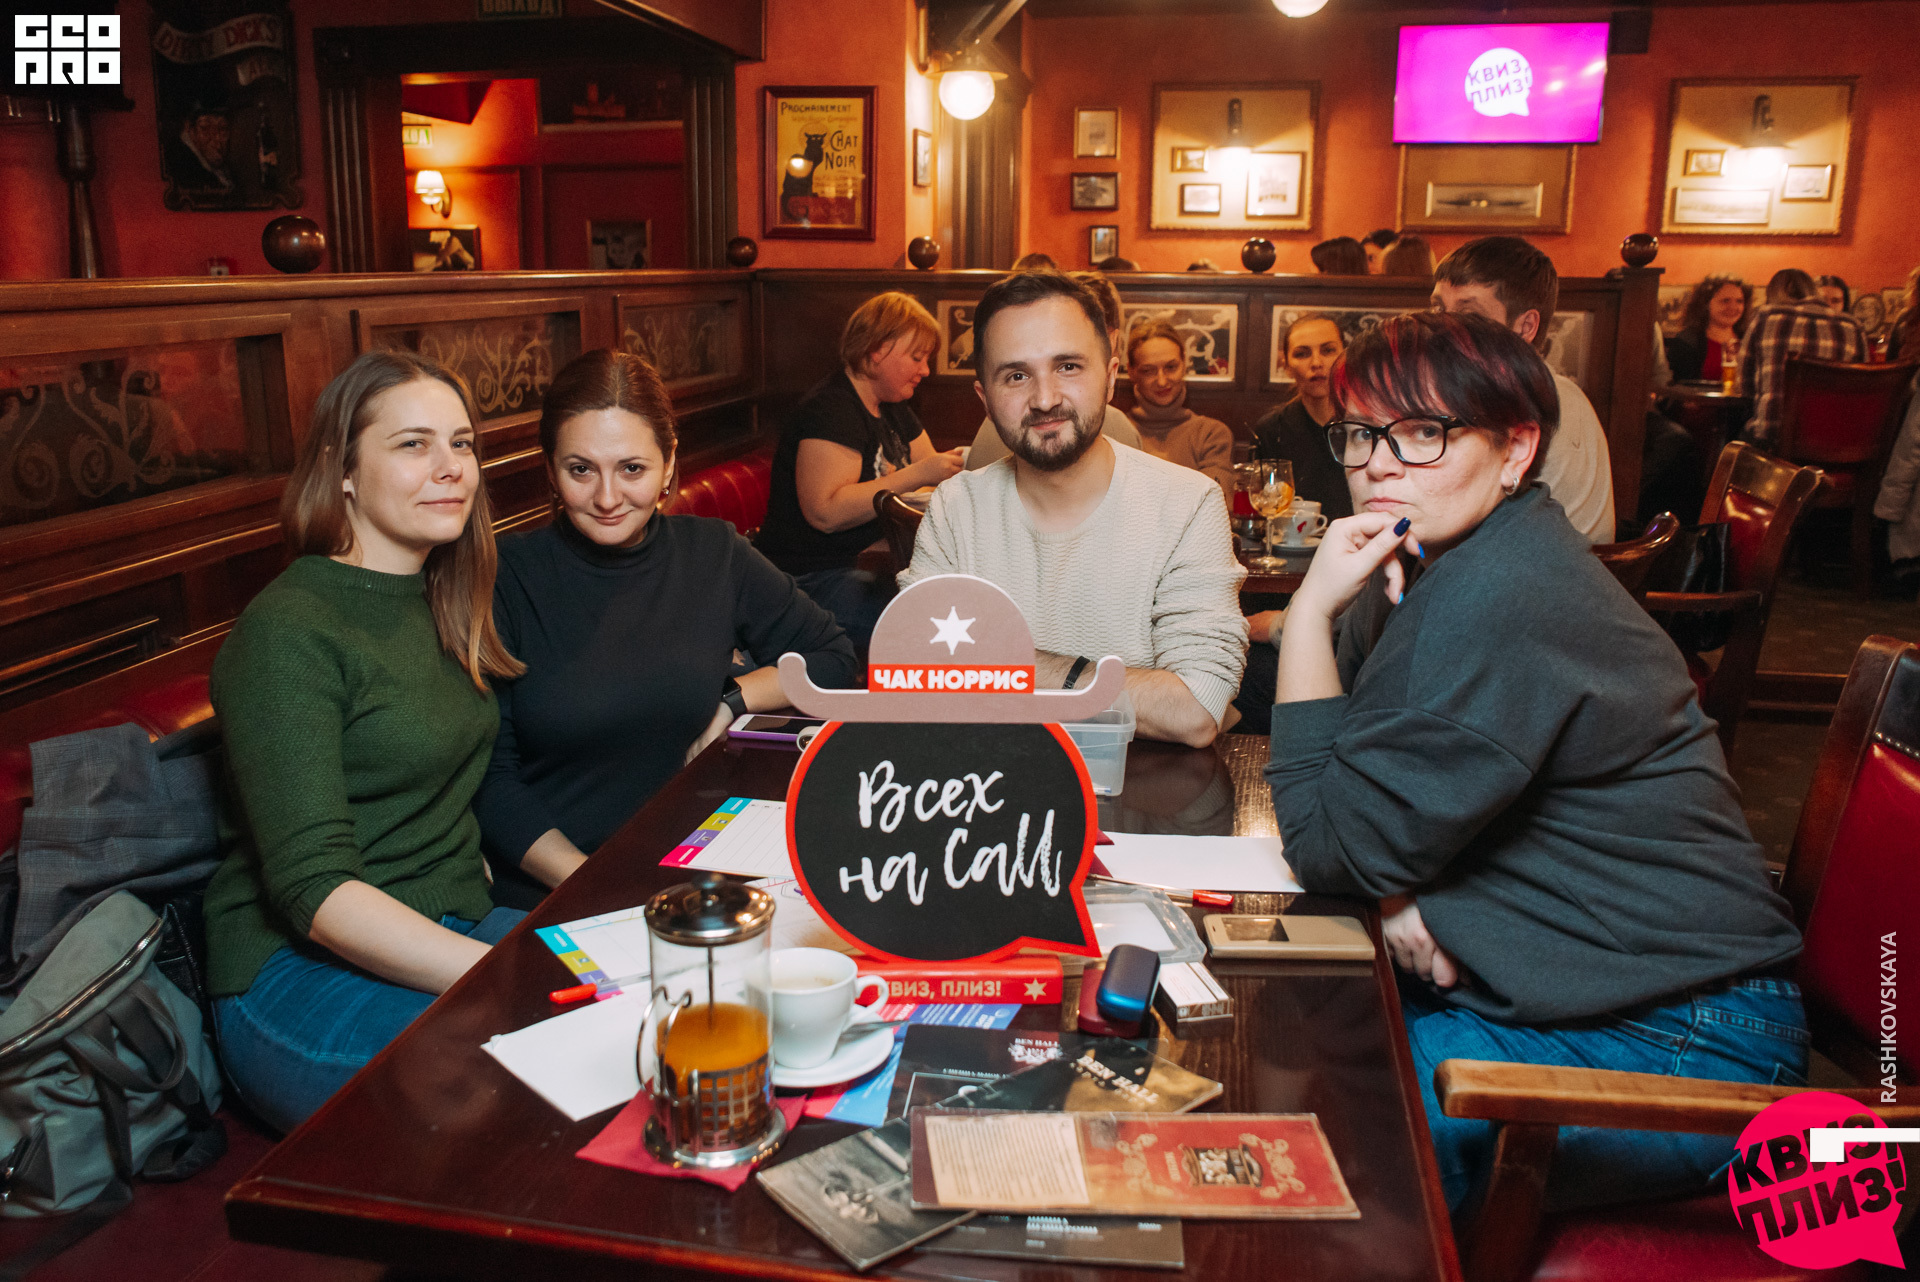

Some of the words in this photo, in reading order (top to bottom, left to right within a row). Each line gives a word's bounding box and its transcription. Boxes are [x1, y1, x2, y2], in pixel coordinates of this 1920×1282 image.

[781, 102, 851, 115] PROCHAINEMENT
[830, 130, 858, 152] CHAT
[825, 152, 856, 170] NOIR
[874, 669, 924, 689] ЧАК
[928, 669, 1029, 690] НОРРИС
[859, 760, 1005, 833] Всех
[839, 851, 929, 906] на
[943, 809, 1063, 897] Call
[941, 981, 1002, 998] ПЛИЗ!
[1077, 1055, 1116, 1080] BEN
